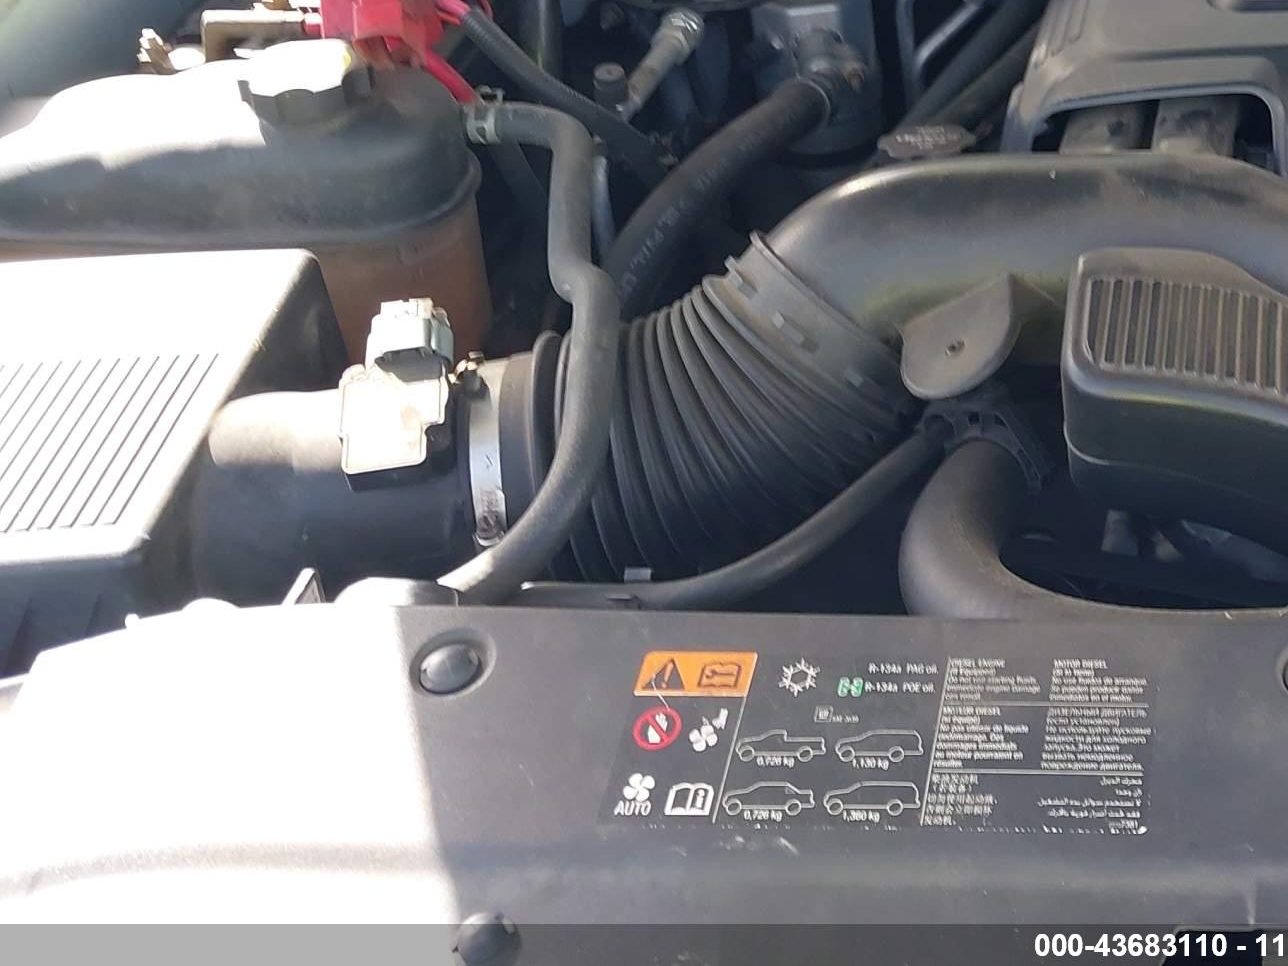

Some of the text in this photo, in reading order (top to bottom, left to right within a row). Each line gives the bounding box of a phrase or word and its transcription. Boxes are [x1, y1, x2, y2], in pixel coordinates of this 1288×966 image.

[906, 663, 924, 675] PAG
[783, 756, 795, 769] kg
[877, 758, 890, 771] kg
[613, 800, 652, 816] AUTO
[770, 809, 783, 822] kg
[868, 810, 881, 823] kg
